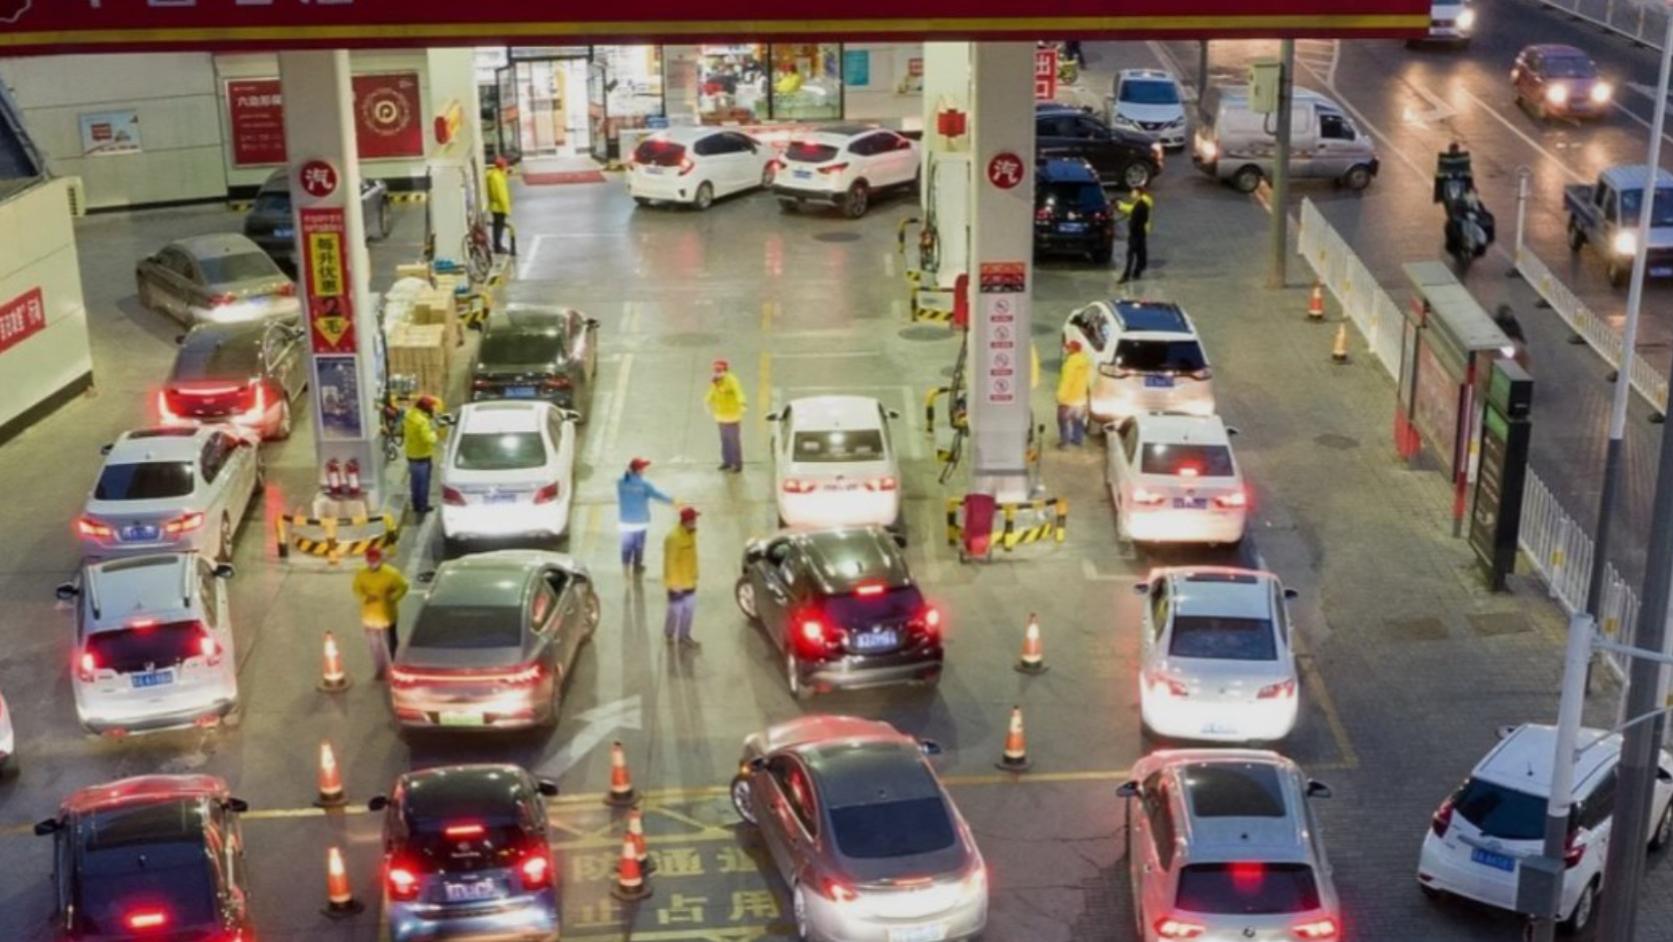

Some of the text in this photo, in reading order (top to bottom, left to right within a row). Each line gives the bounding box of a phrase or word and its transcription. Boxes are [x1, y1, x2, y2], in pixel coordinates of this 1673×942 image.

[305, 167, 333, 190] 汽
[994, 160, 1018, 183] 汽
[318, 238, 337, 292] 每升优惠
